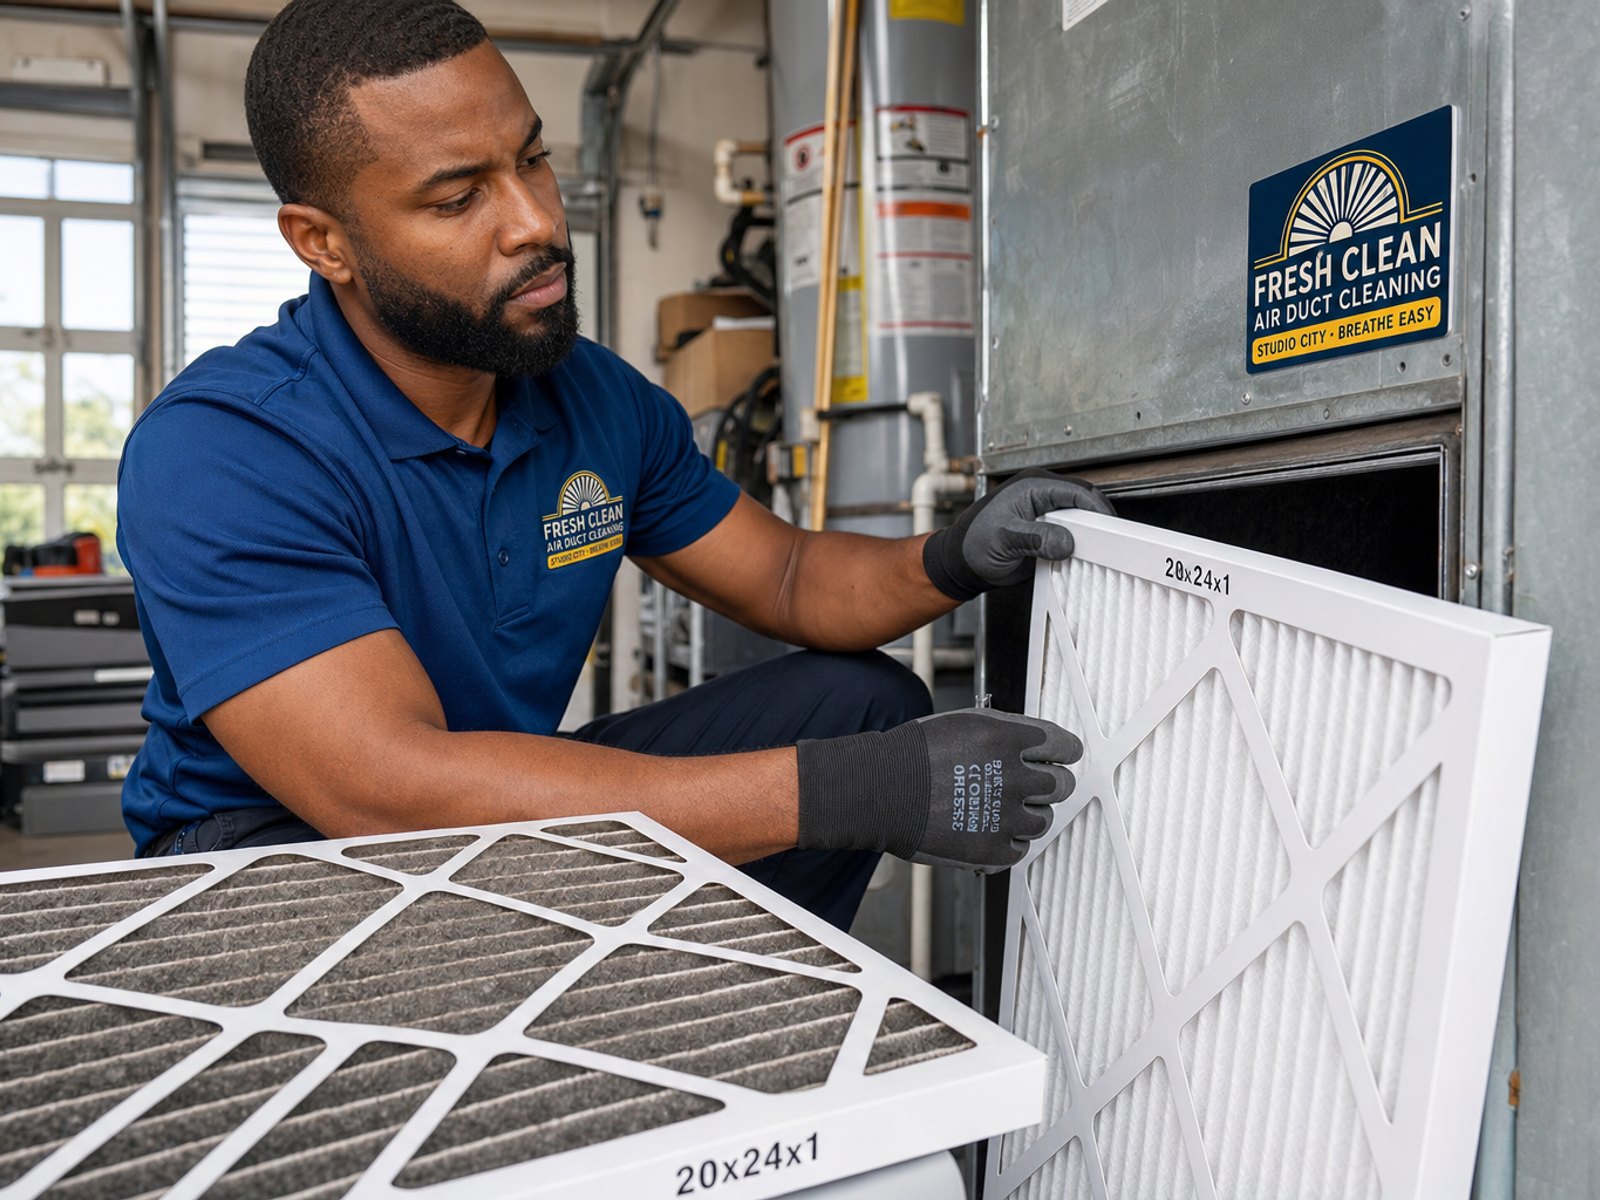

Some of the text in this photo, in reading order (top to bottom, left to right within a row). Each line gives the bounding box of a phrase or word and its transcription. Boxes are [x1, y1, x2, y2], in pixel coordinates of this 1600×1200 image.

[1254, 221, 1442, 307] FRESH CLEAN
[1253, 265, 1441, 332] AIR DUCT CLEANING
[1257, 304, 1435, 358] STUDIO CITY BREATHE EASY
[543, 502, 624, 541] FRESH CLEAN
[546, 540, 563, 553] AIR
[564, 533, 587, 549] DUCT
[1165, 557, 1229, 595] 20x24x1
[676, 1132, 818, 1196] 20x24x1
